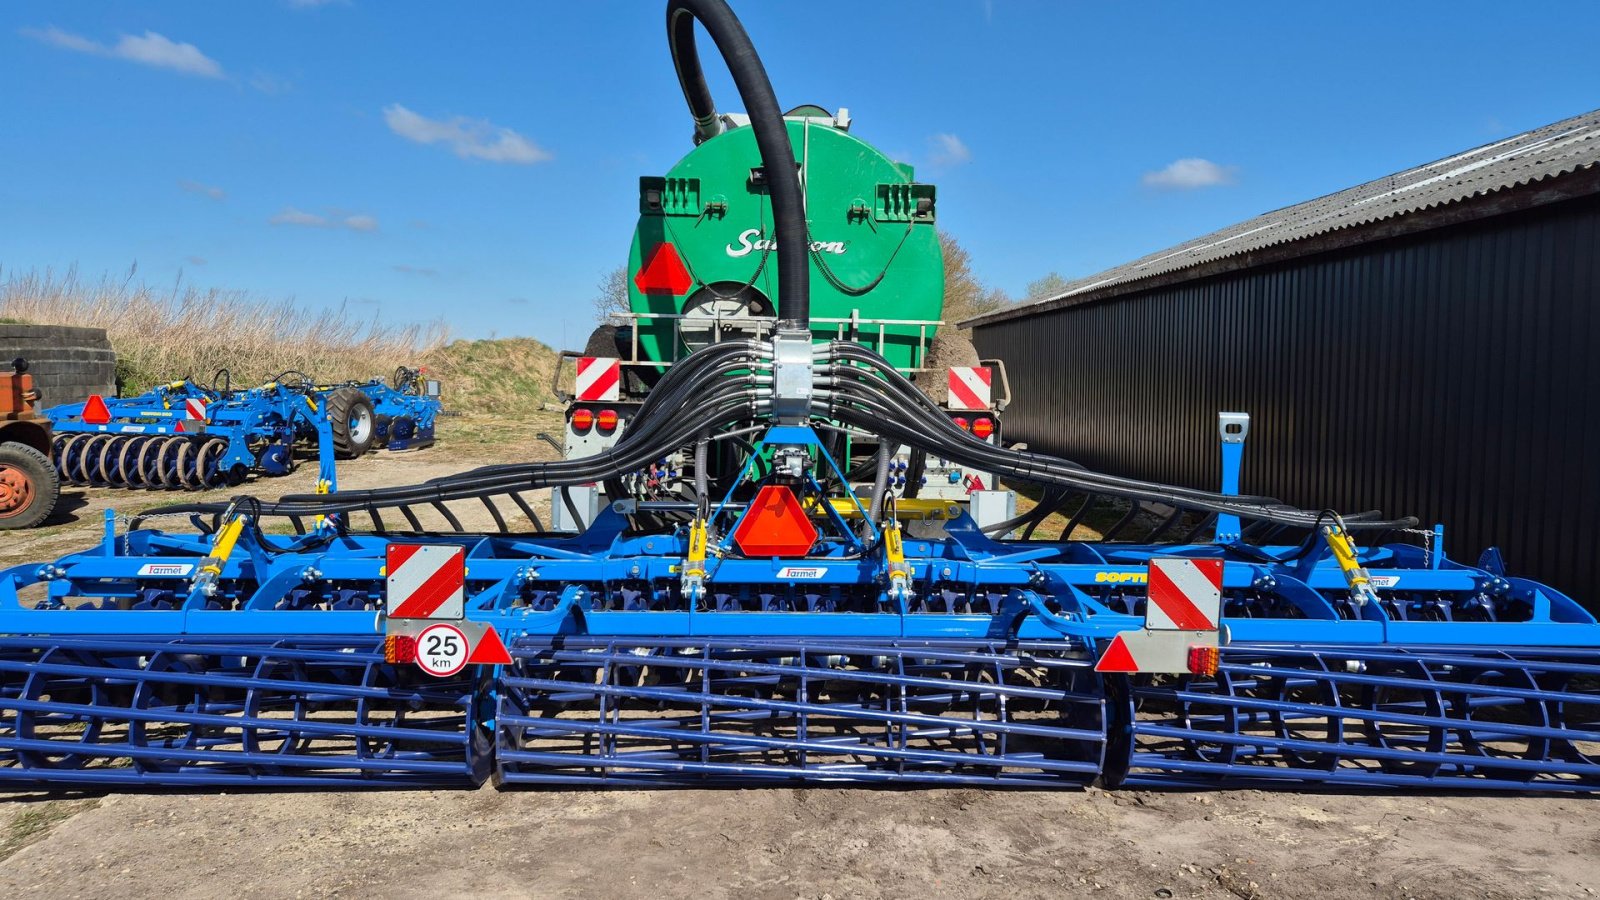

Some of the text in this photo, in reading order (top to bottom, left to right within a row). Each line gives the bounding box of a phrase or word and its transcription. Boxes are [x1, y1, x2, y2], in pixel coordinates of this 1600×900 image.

[726, 228, 847, 257] Saon
[149, 565, 182, 574] Farmet
[786, 568, 817, 577] Farmet
[427, 635, 458, 656] 25
[432, 657, 451, 668] km
